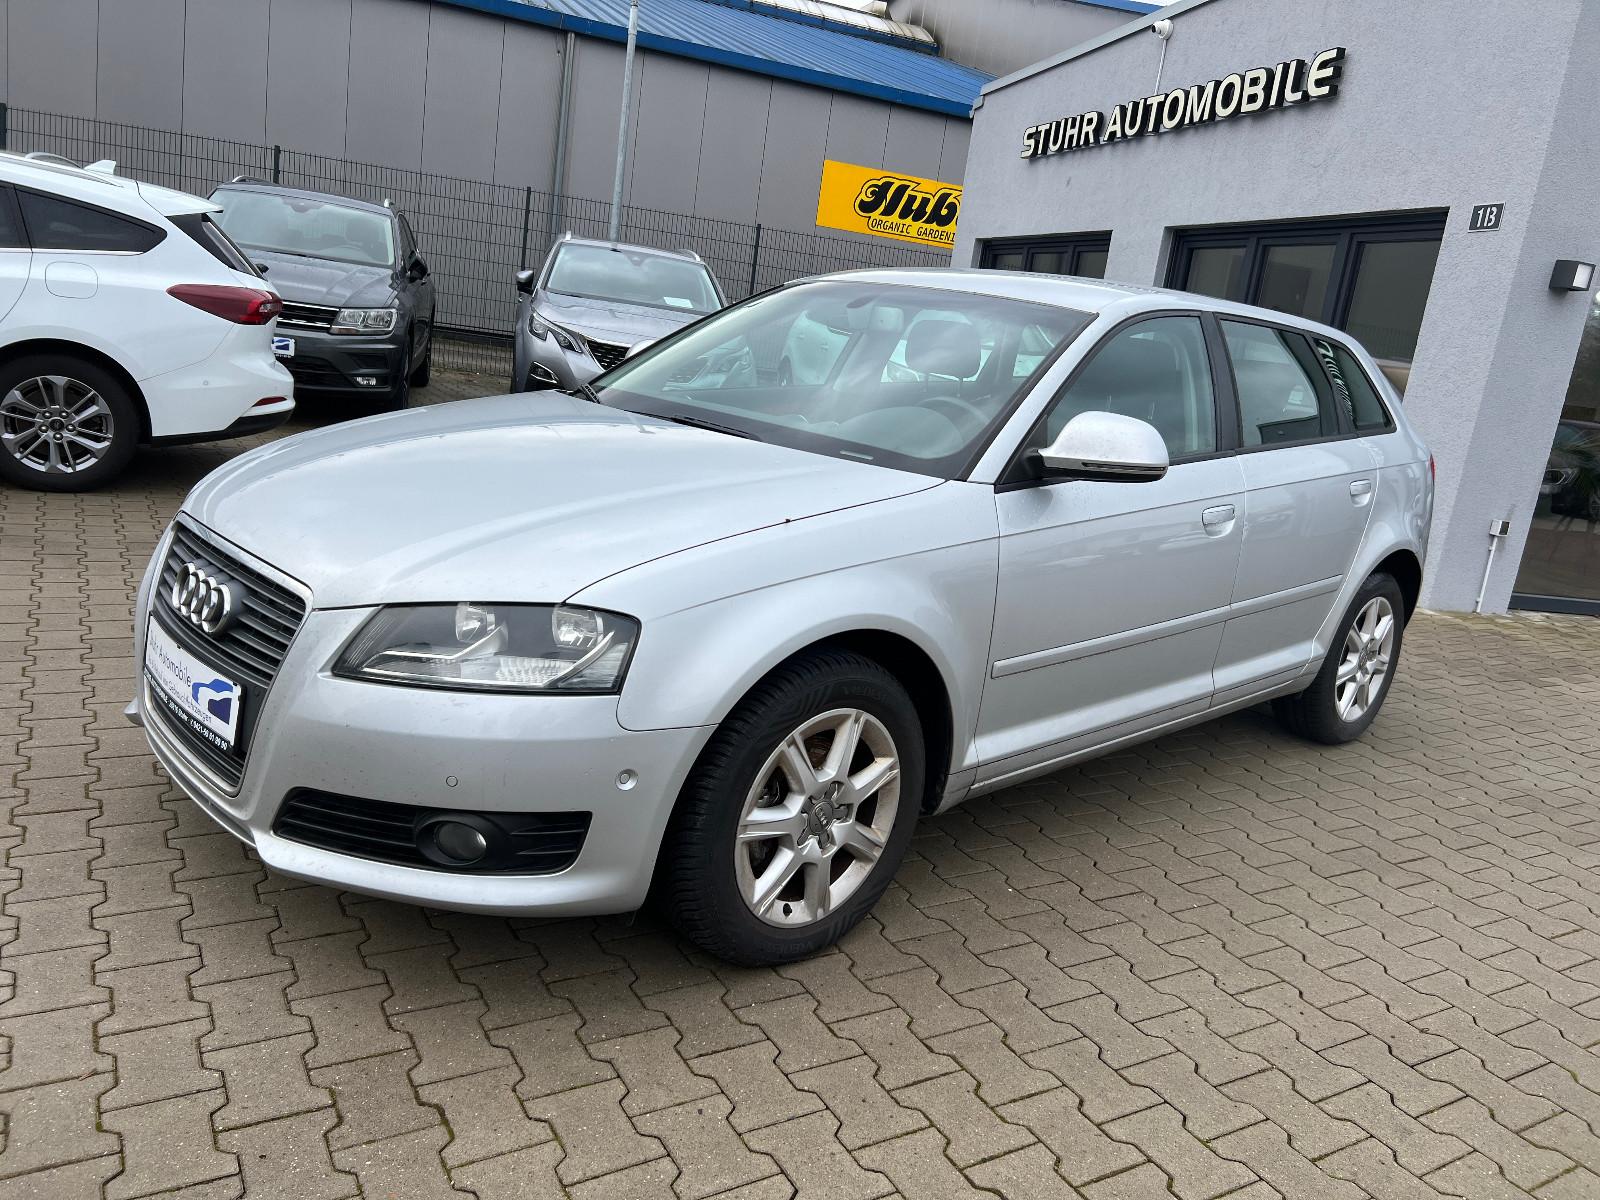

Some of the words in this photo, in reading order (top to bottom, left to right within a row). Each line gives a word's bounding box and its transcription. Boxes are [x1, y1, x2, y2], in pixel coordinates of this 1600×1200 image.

[1021, 110, 1102, 159] STUHR
[1103, 47, 1346, 142] AUTOMOBILE
[858, 181, 959, 227] Hub
[871, 218, 913, 235] ORGANIC
